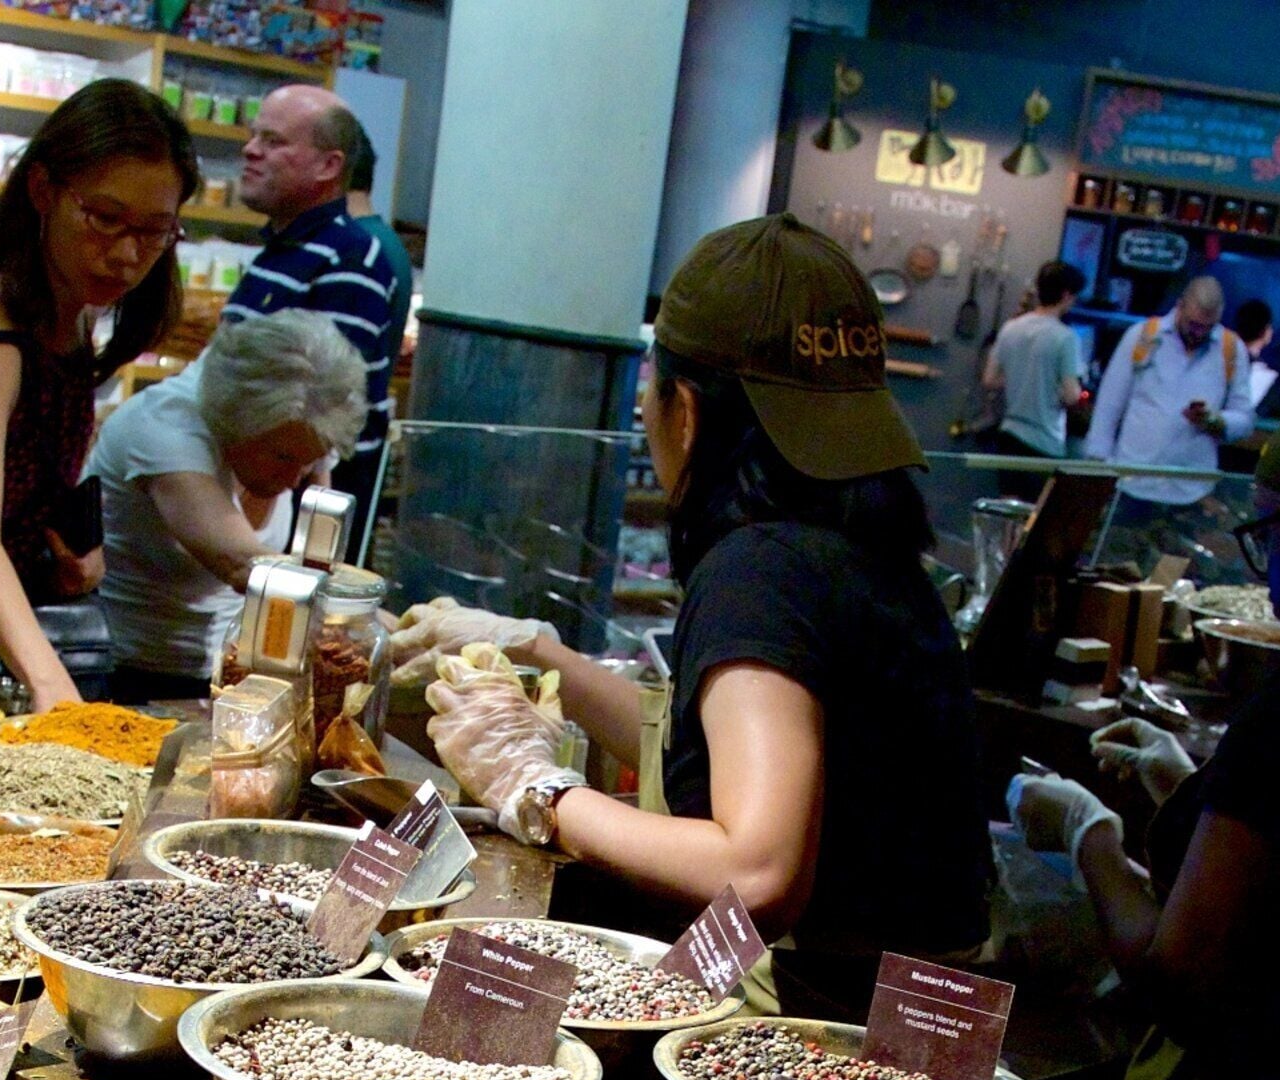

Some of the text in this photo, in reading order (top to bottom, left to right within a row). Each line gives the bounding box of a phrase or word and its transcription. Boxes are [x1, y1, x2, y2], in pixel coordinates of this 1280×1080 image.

[482, 948, 535, 973] White Pepper
[465, 982, 485, 996] From
[911, 971, 975, 994] Mustard Pepper
[903, 1006, 934, 1021] peppers
[935, 1014, 957, 1026] blend
[957, 1020, 973, 1031] and
[905, 1018, 960, 1039] mustard seeds
